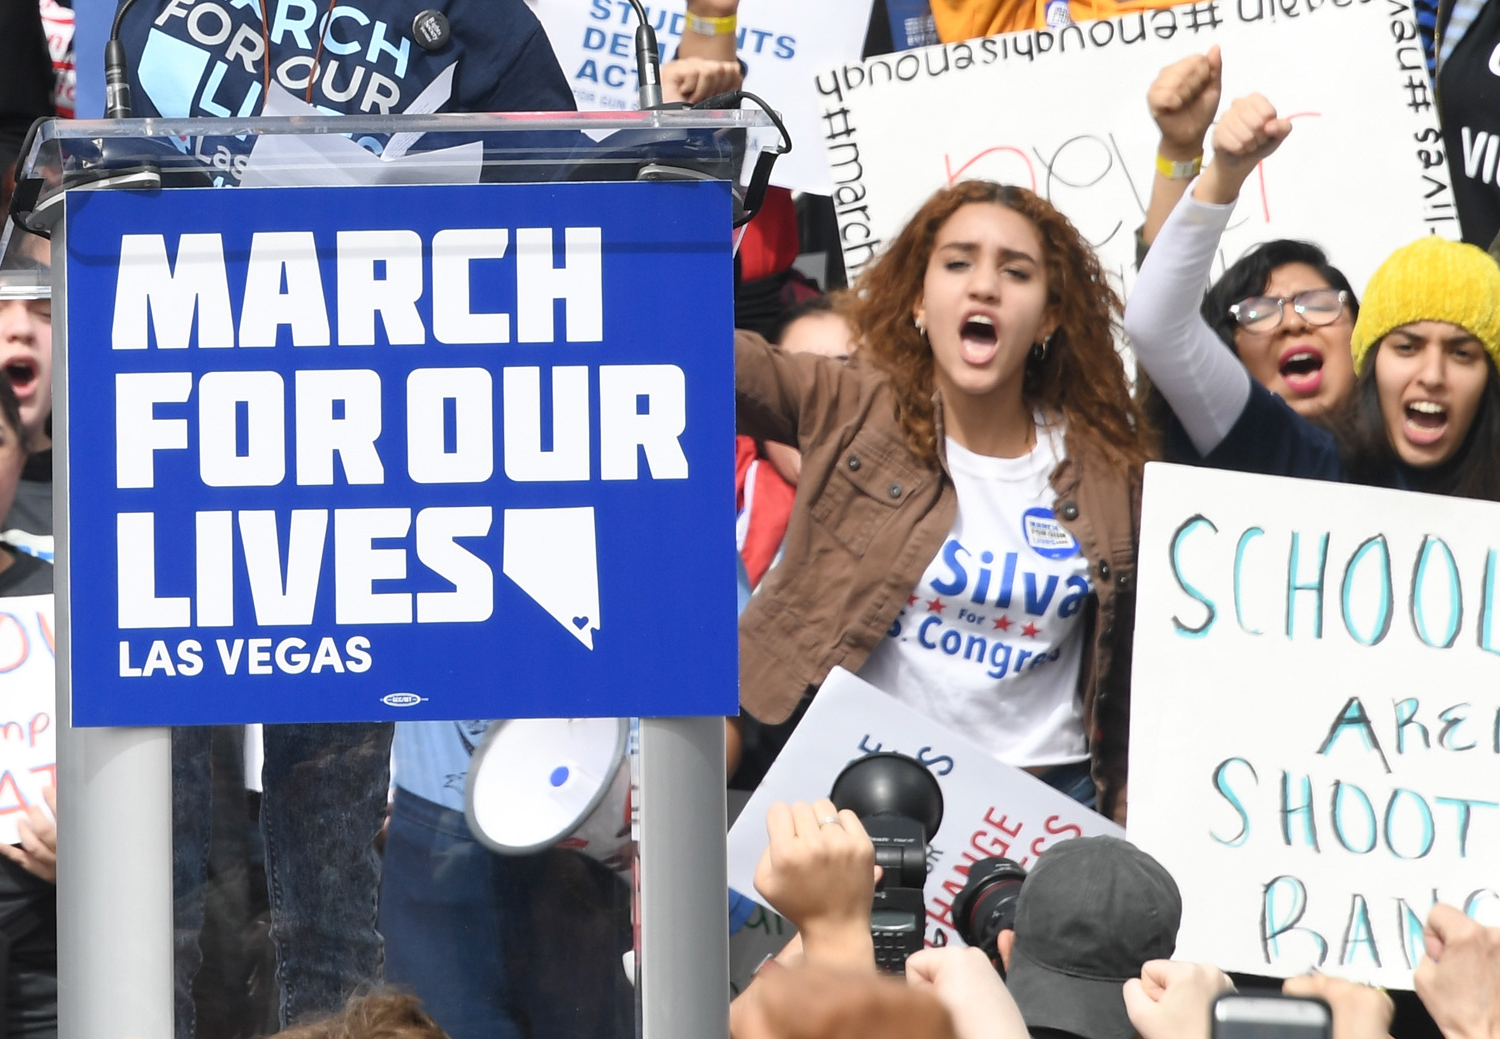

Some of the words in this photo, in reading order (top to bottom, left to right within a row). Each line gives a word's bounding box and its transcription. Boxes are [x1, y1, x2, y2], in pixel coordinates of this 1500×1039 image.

[276, 55, 401, 120] OUR
[1461, 126, 1500, 186] VI
[112, 227, 602, 349] MARCH
[116, 369, 385, 488] FOR
[406, 364, 689, 483] OUR
[117, 505, 494, 629] LIVES
[930, 539, 1090, 620] Silva
[1169, 513, 1500, 657] SCHOOL
[119, 640, 203, 677] LAS
[216, 636, 372, 677] VEGAS
[958, 608, 985, 625] For
[1209, 756, 1500, 860] SHOOT
